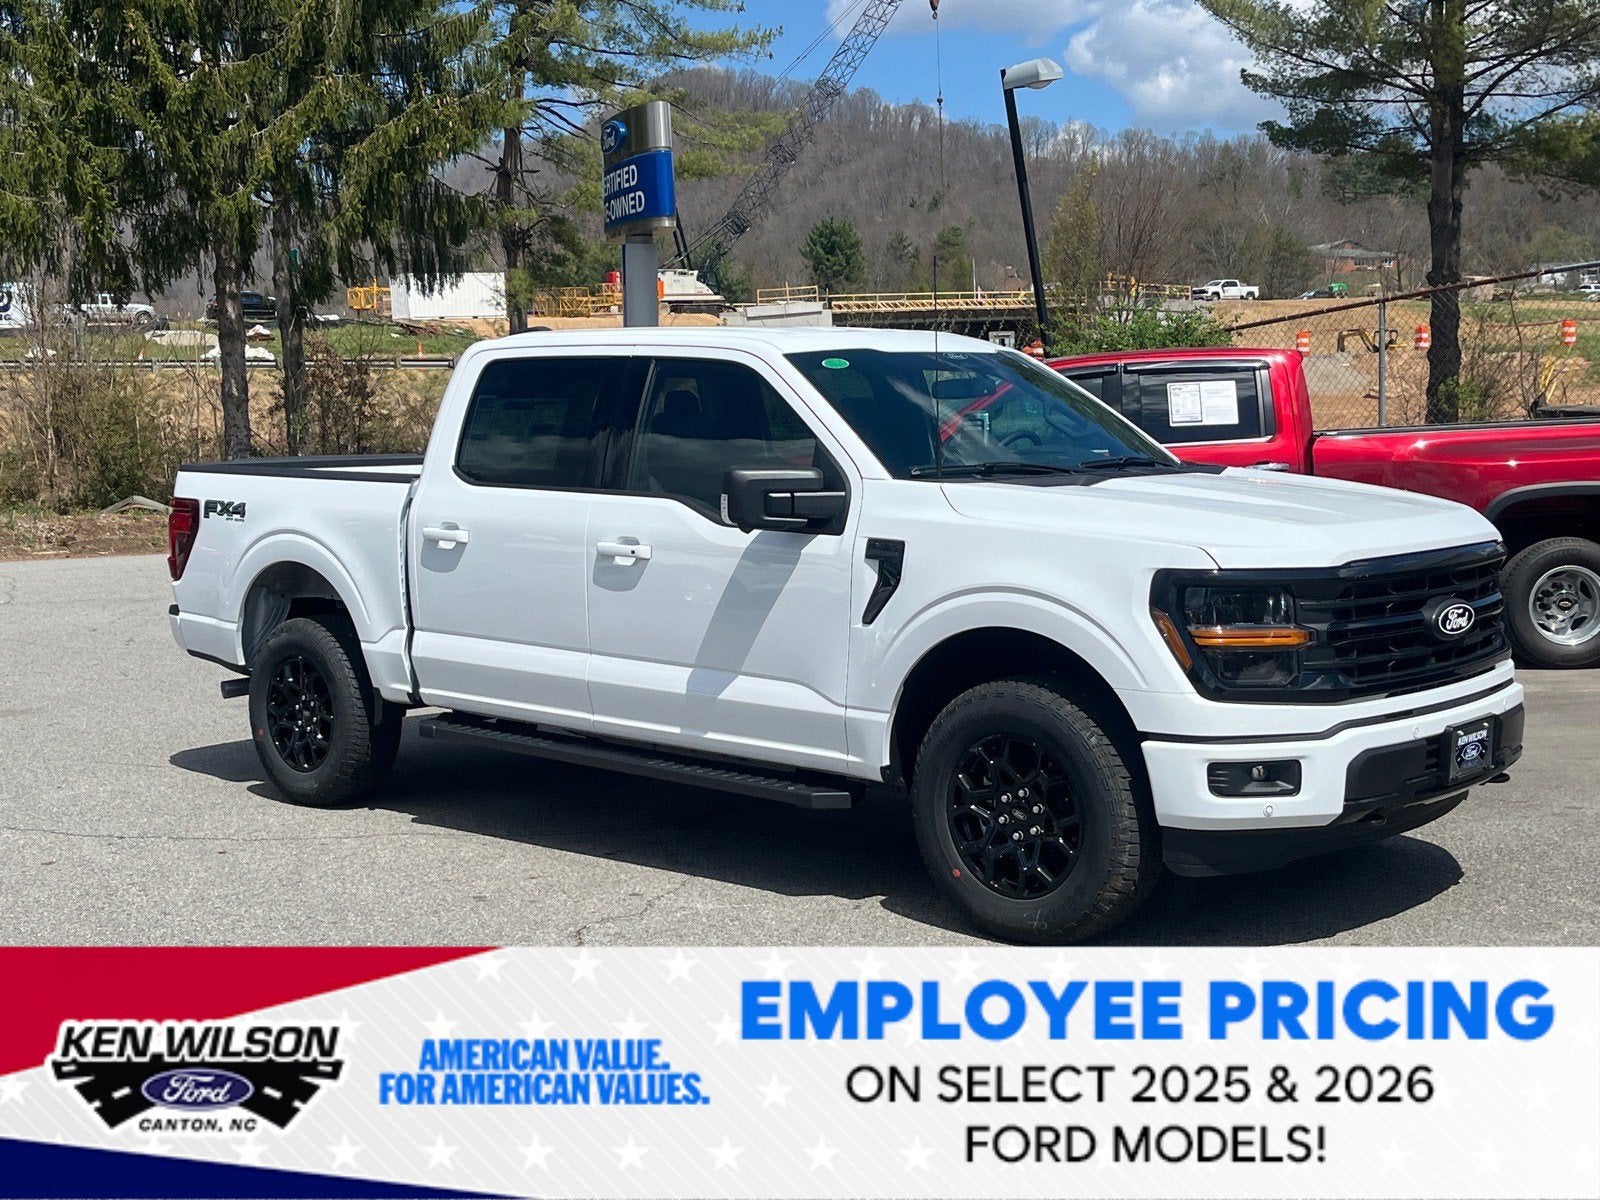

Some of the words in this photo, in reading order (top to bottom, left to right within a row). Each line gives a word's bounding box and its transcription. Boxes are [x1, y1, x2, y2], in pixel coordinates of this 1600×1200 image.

[604, 164, 638, 196] ERTIFIED
[605, 190, 645, 223] E-OWNED
[203, 499, 246, 519] FX4
[1446, 608, 1469, 630] Ford
